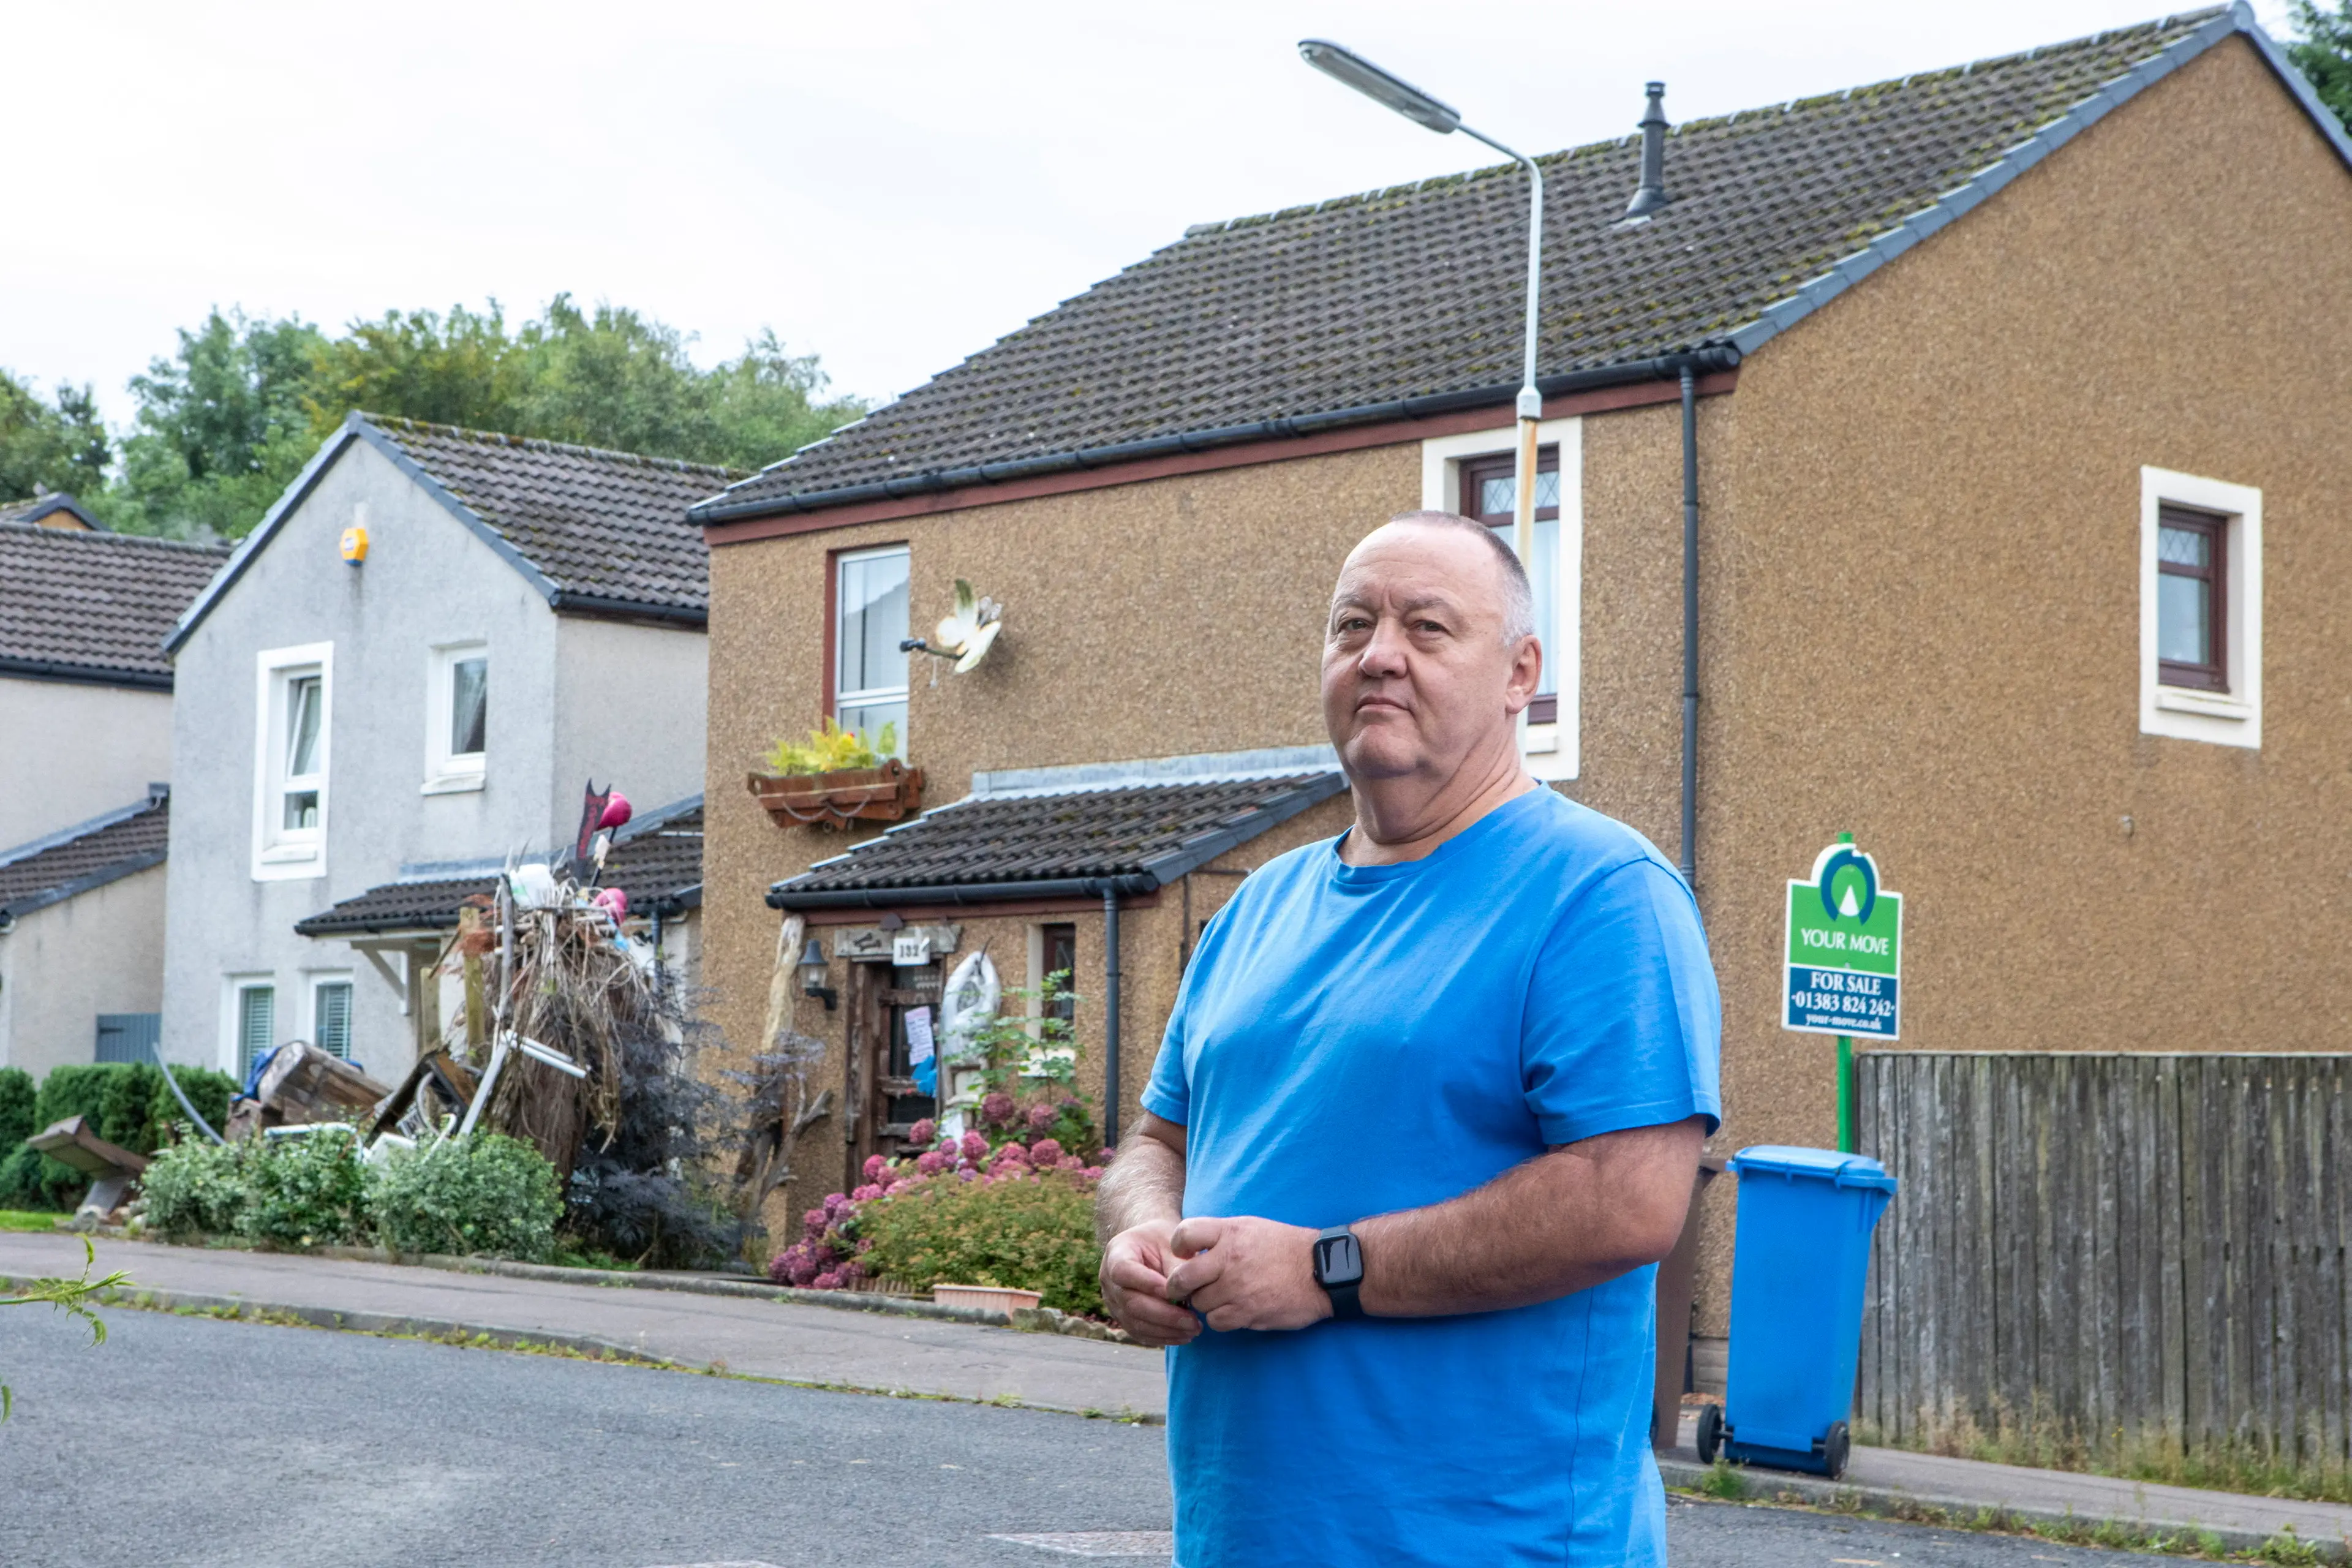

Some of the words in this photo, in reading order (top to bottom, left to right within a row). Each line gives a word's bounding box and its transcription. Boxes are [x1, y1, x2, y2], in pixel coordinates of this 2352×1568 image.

[899, 944, 919, 958] 132
[1801, 928, 1845, 949] YOUR
[1849, 933, 1889, 956] MOVE
[1811, 971, 1844, 991] FOR
[1846, 975, 1882, 995] SALE
[1842, 995, 1867, 1014] 824
[1806, 1014, 1882, 1031] your-move.co.uk
